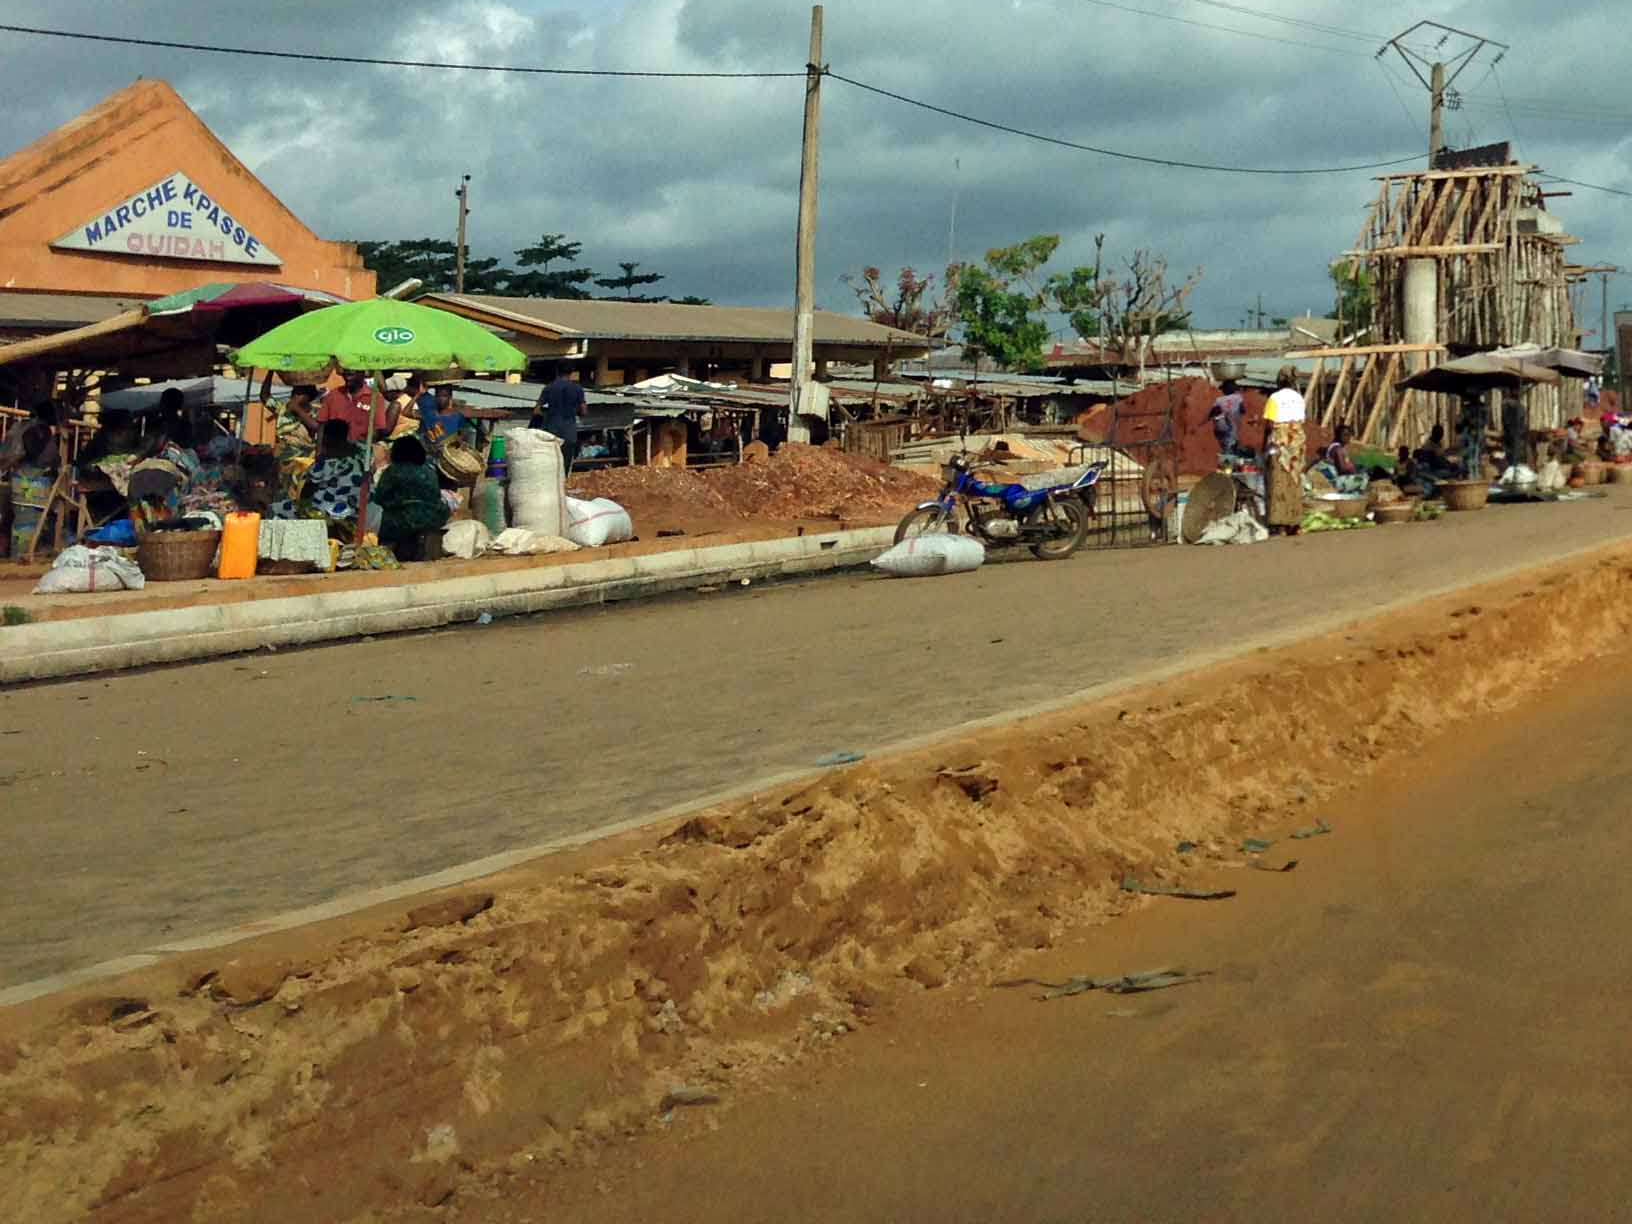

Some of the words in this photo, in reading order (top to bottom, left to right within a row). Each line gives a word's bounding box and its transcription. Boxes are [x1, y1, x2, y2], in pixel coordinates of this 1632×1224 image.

[85, 179, 177, 246] MARCHE
[183, 183, 260, 258] KPASSE
[167, 210, 193, 229] DE
[127, 232, 225, 259] OUIDAH
[379, 330, 413, 343] glo
